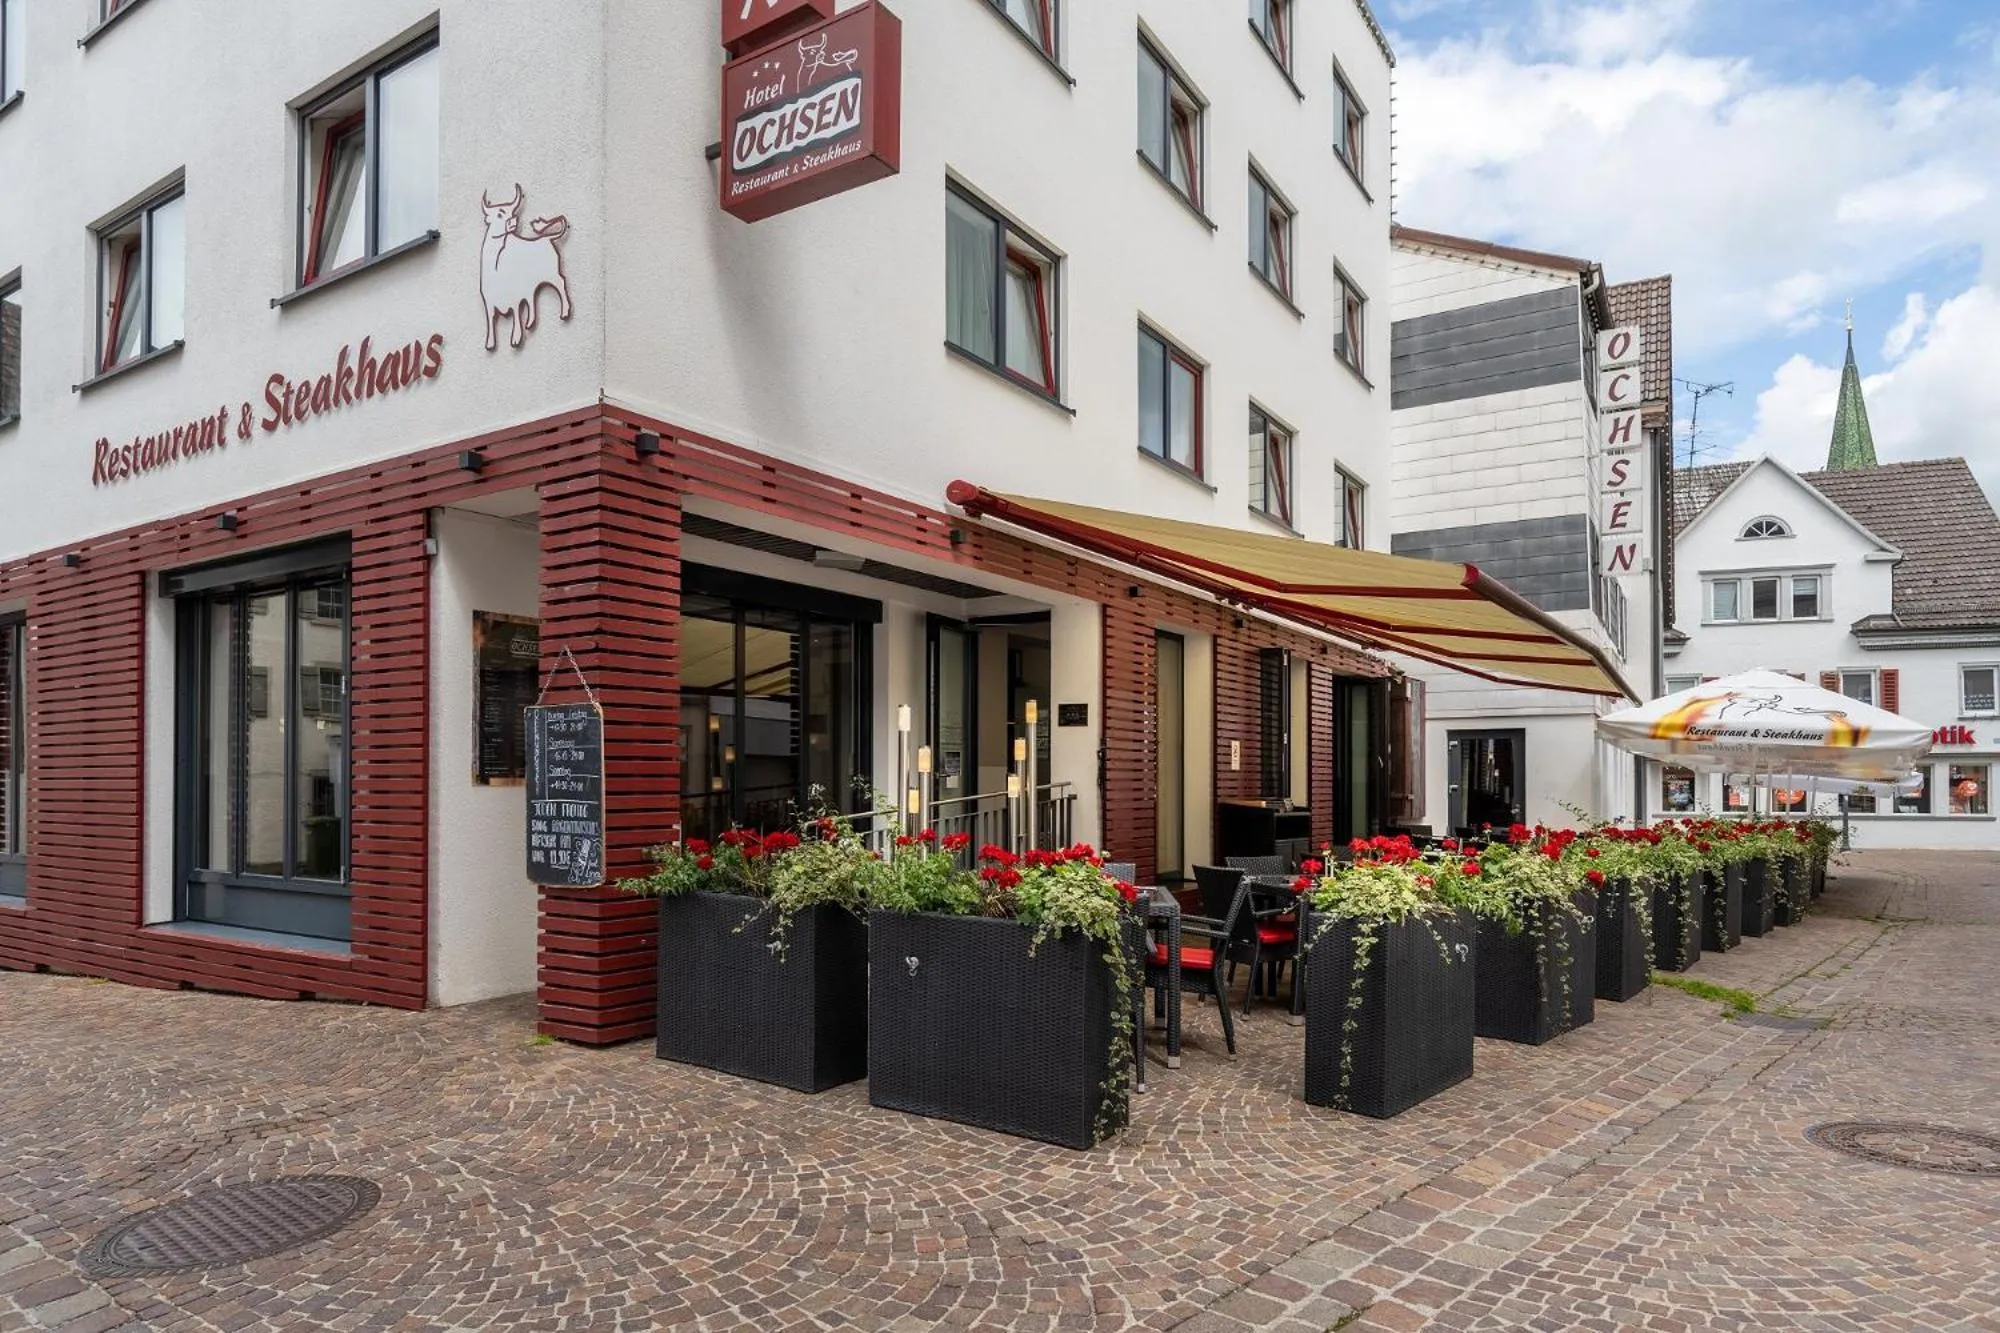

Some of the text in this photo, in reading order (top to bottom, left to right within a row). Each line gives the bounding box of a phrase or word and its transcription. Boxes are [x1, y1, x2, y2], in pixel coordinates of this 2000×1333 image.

[735, 82, 860, 163] OCHSEN
[744, 74, 786, 110] Hotel
[731, 166, 790, 196] Restaurant
[802, 140, 862, 172] Steakhaus
[92, 333, 444, 487] Restaurant & Steakhaus
[1606, 331, 1637, 572] OCHSEN
[1687, 726, 1824, 741] Restaurant & Steakhaus
